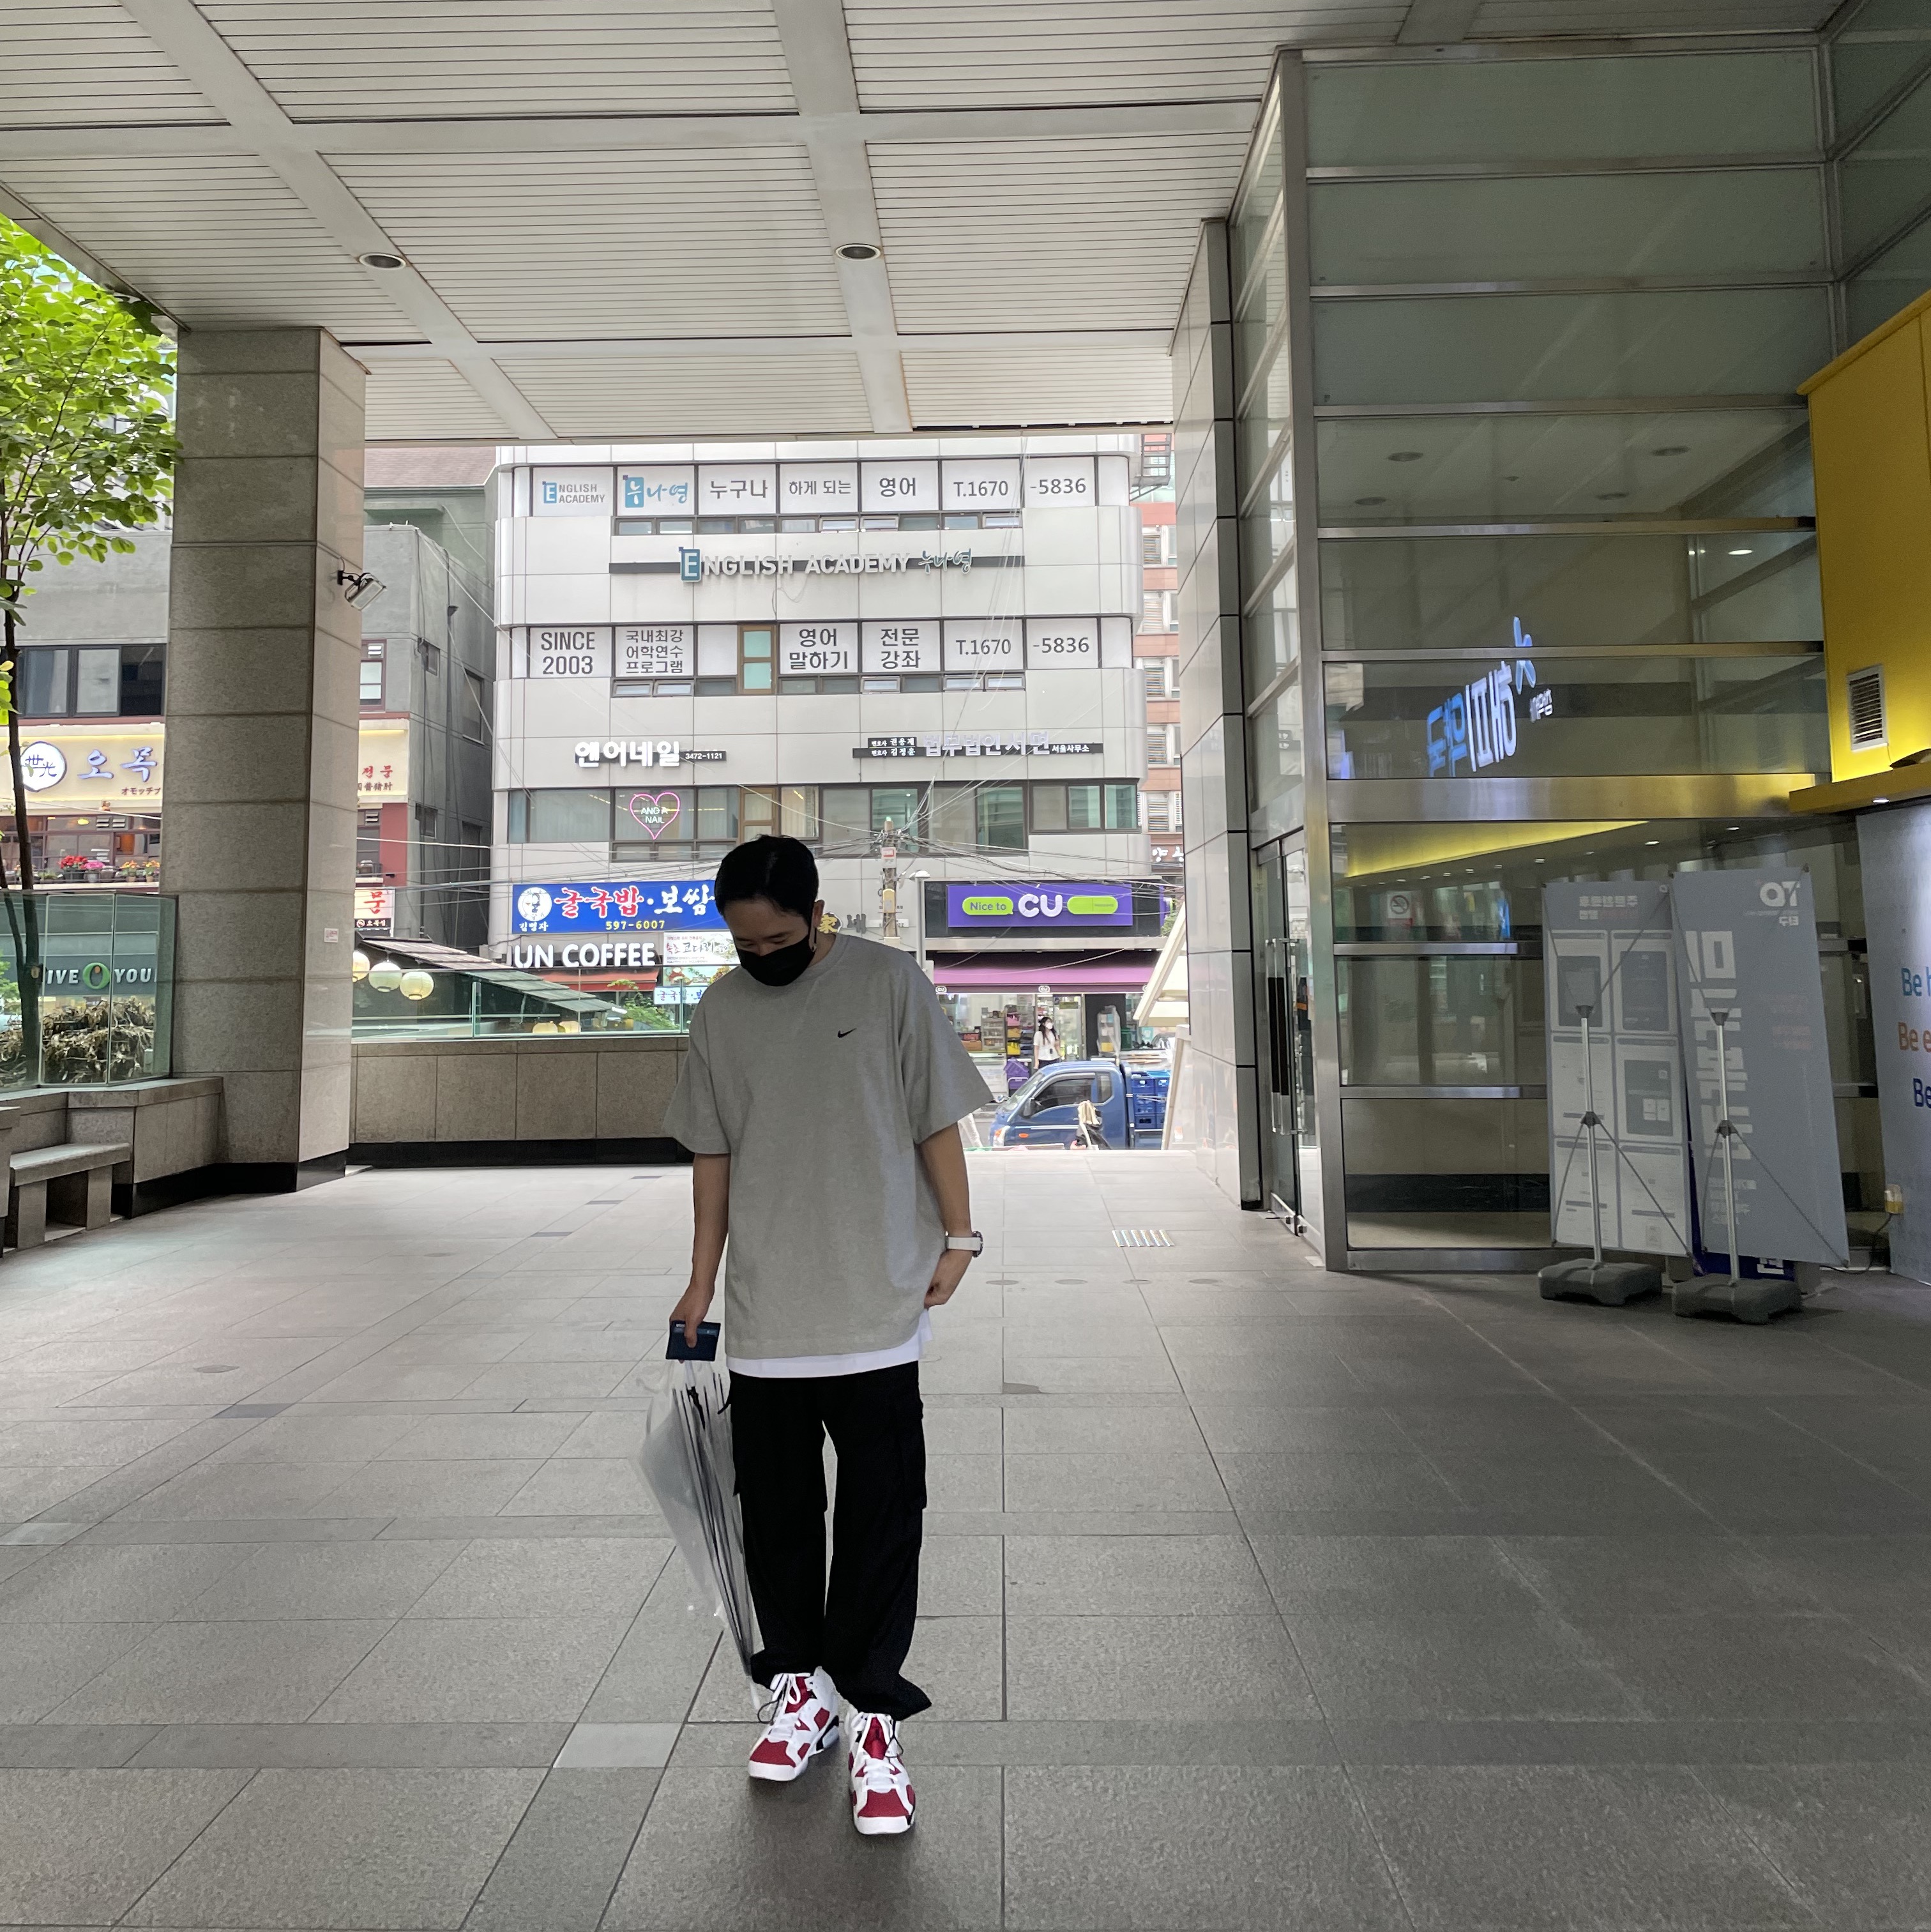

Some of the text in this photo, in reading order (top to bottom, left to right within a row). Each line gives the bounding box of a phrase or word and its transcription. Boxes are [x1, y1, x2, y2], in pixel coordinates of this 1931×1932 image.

[623, 476, 688, 508] 누나영
[709, 476, 917, 499] 누구나 하게 되는 영어
[953, 478, 1087, 498] T.1670 -5836
[558, 494, 605, 504] ACADEMY
[679, 548, 794, 582] ENGLISH
[803, 553, 911, 575] ACADEMY
[540, 632, 596, 651] SINCE
[626, 629, 684, 644] 국내최강
[798, 628, 838, 647] 영어
[879, 627, 920, 648] 전문
[955, 637, 1089, 656] T.1670 -5836
[626, 645, 684, 659] 어학연수
[789, 651, 849, 670] 말하기
[880, 649, 921, 670] 강좌
[542, 655, 594, 675] 2003
[626, 660, 684, 674] 프로그램
[575, 740, 723, 768] 앤어네일 3472-1121
[923, 731, 1090, 757] 법무법인 서면 서울사무소
[645, 816, 665, 824] NAIL
[969, 893, 1063, 918] Nice to CU
[605, 920, 665, 931] 597-6007
[563, 942, 656, 968] COFFEE
[114, 968, 156, 984] YOU
[1901, 968, 1923, 997] Be
[1898, 1021, 1920, 1052] Be
